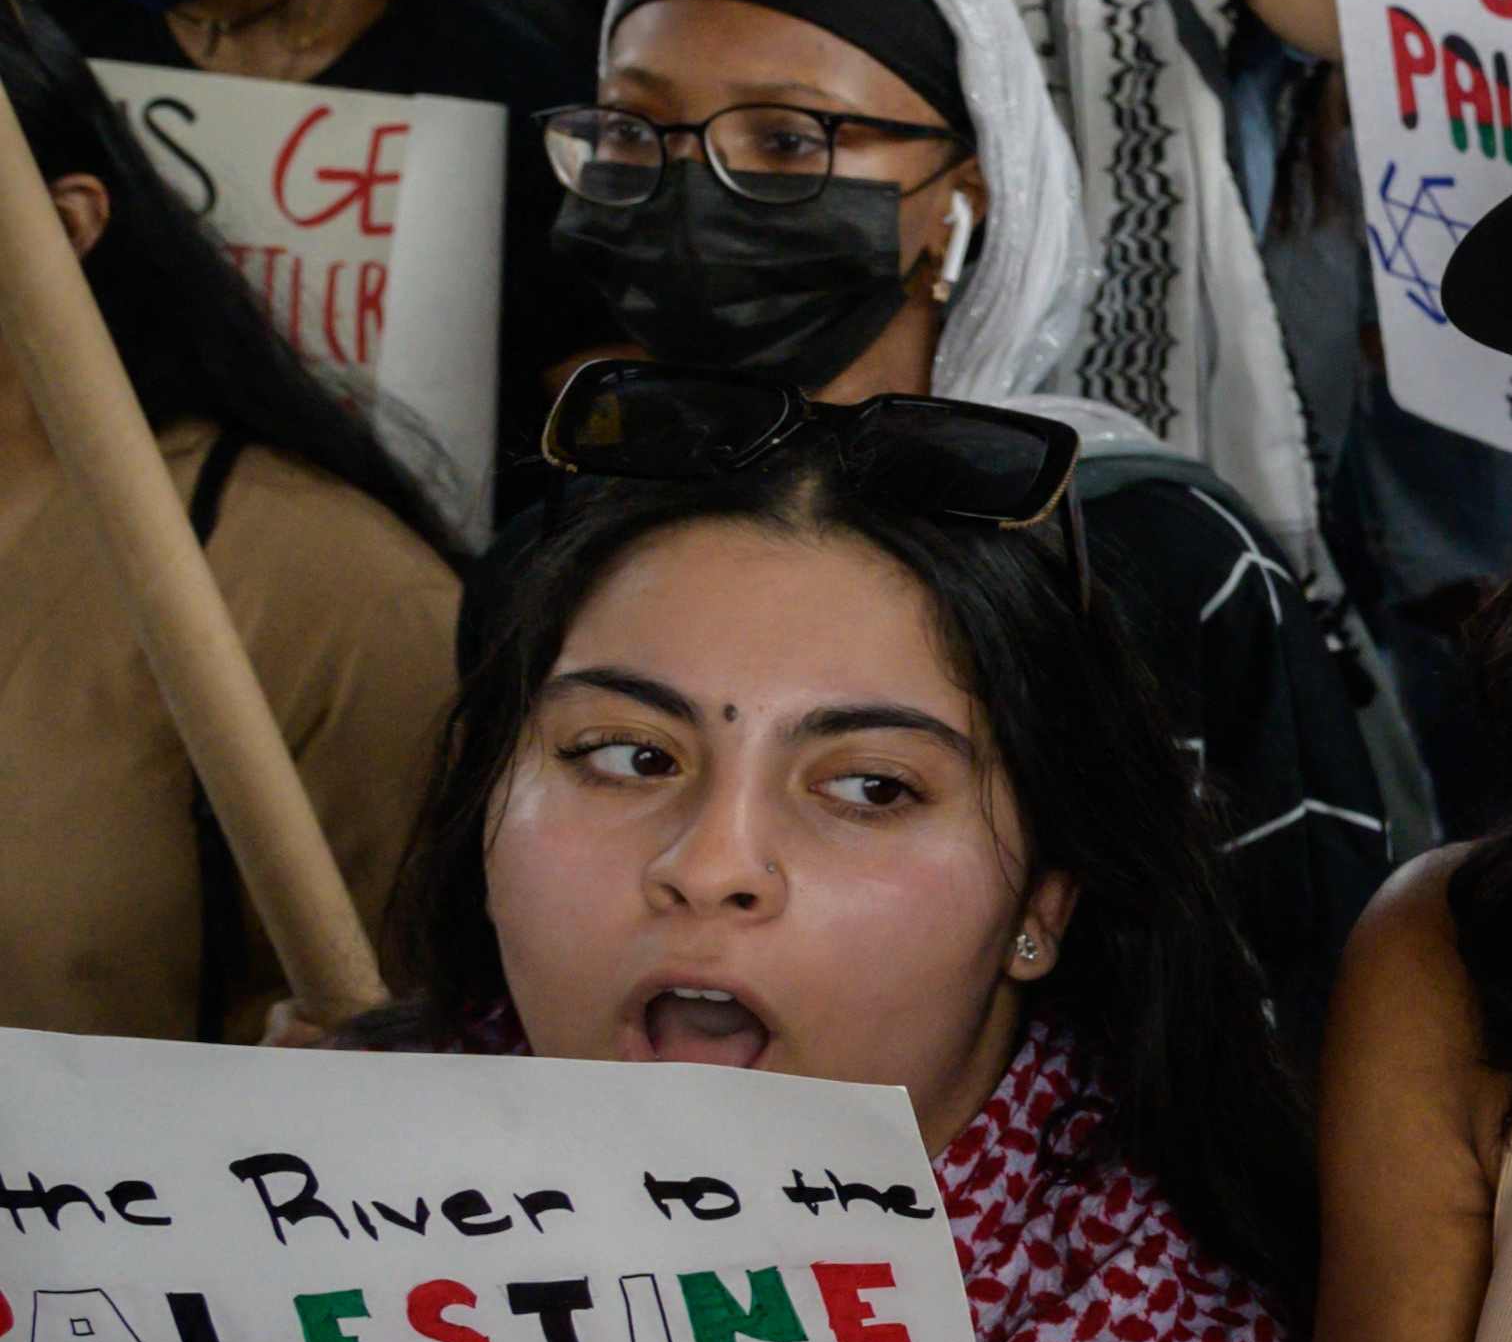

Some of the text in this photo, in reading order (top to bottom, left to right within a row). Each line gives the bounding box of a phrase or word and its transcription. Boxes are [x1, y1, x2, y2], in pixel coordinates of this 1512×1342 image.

[0, 1151, 936, 1246] the River to the
